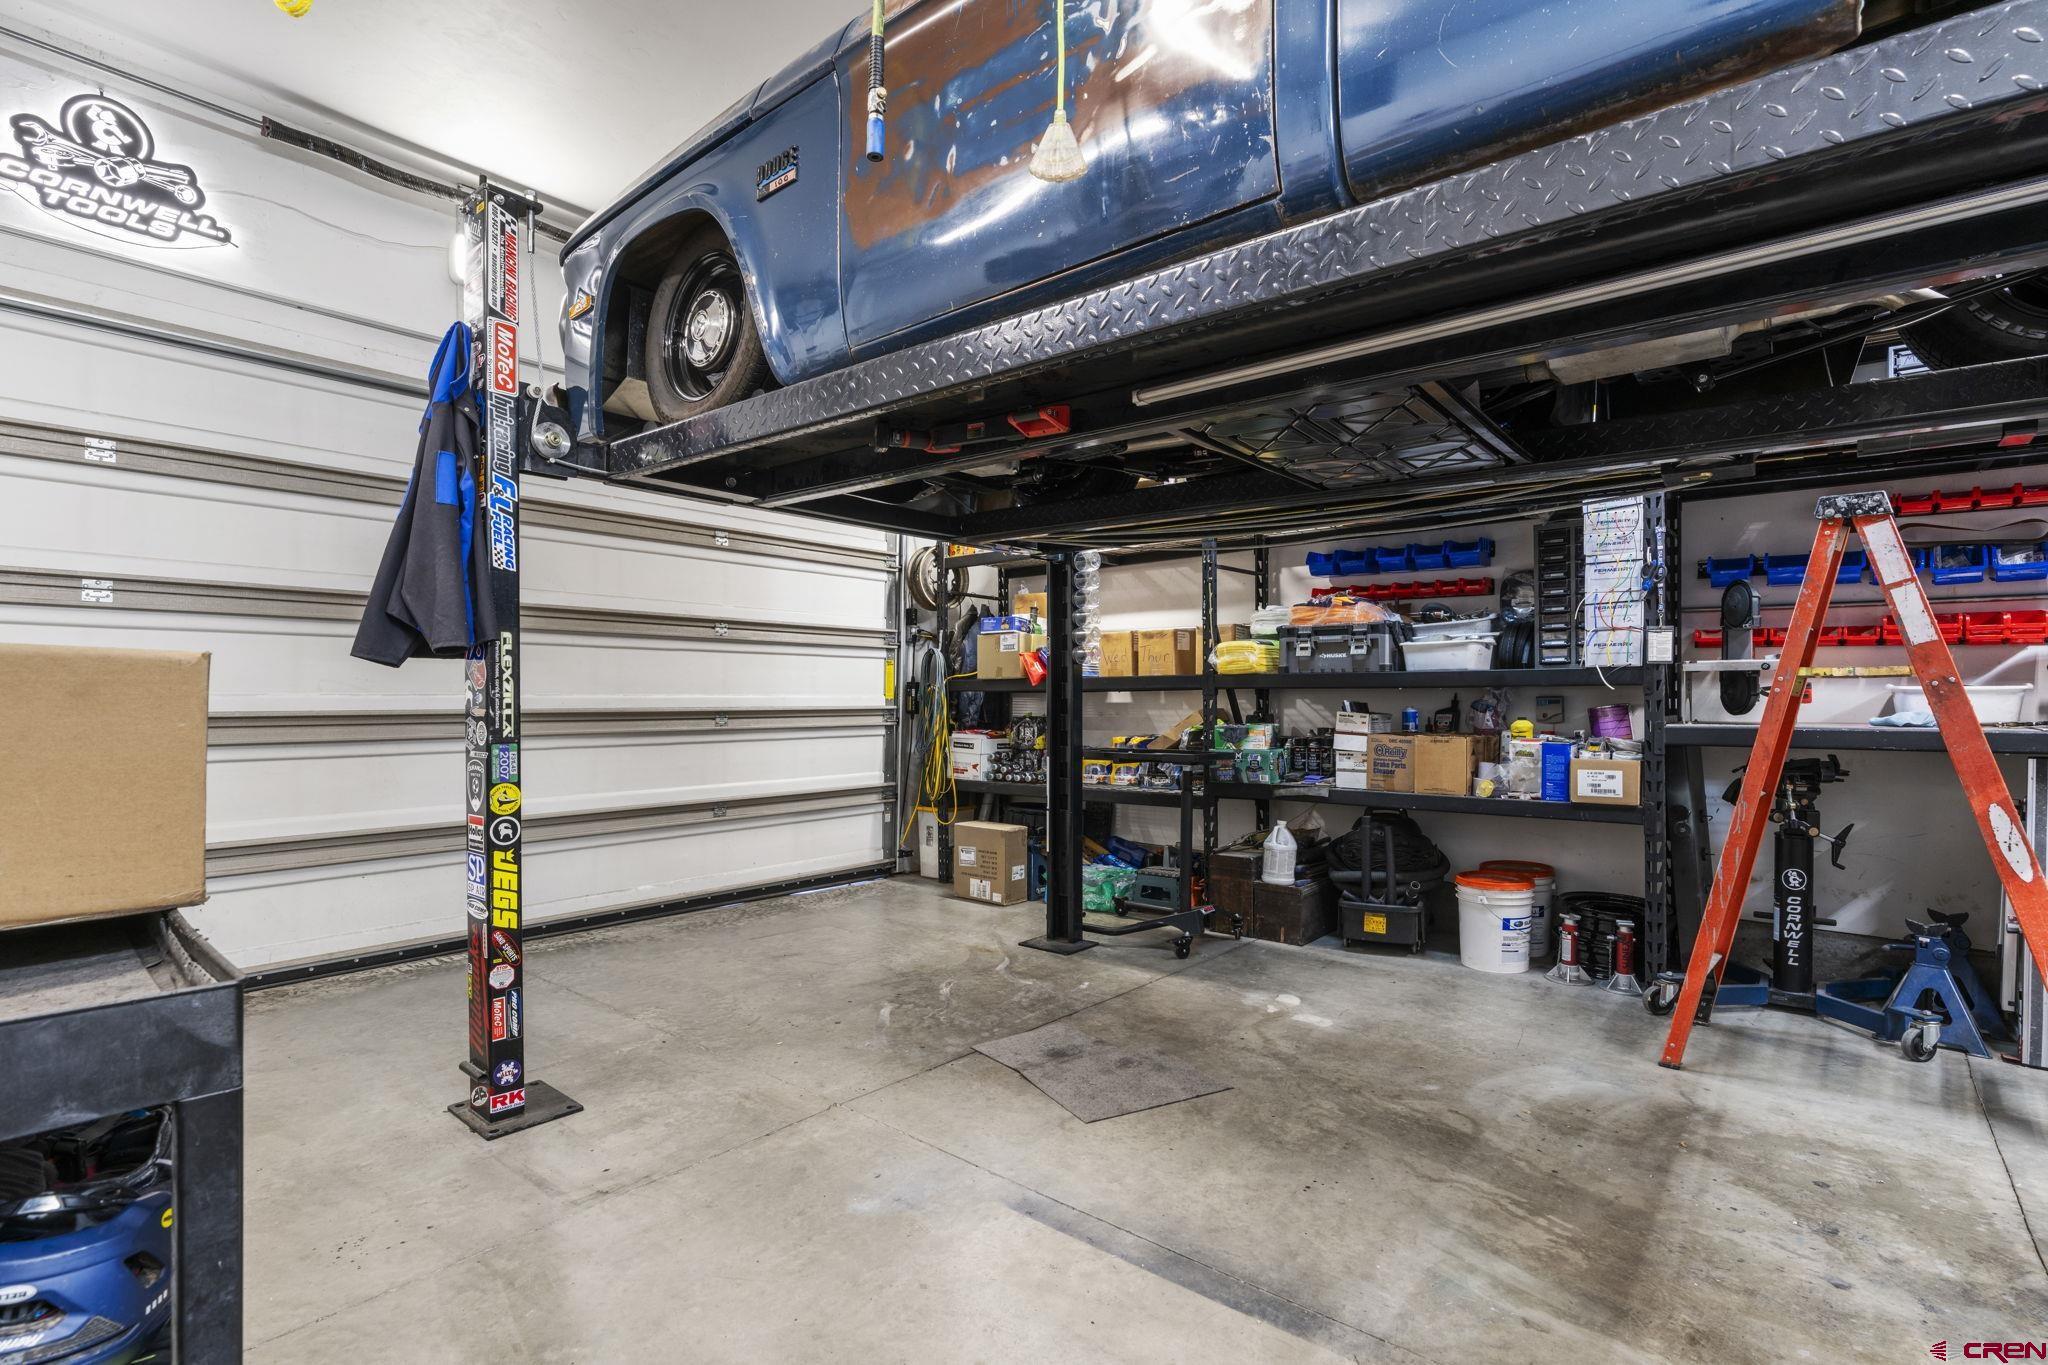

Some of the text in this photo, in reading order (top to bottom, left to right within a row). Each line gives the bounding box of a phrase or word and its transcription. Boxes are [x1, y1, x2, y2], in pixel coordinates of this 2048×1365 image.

[43, 187, 177, 238] TOOLS
[505, 231, 517, 321] MANCINI RACING
[497, 325, 514, 390] MoTeC
[491, 510, 503, 549] FUEL
[502, 515, 517, 572] RACING
[1101, 646, 1127, 665] Wed
[501, 632, 514, 738] FLEXZILLA
[500, 751, 509, 780] 2007
[468, 824, 484, 842] Holley
[468, 854, 485, 883] SP
[493, 850, 518, 930] JEGS
[1783, 896, 1803, 966] CORNWELL
[493, 1001, 502, 1026] MoTeC
[511, 1010, 519, 1037] COMP
[491, 1089, 524, 1109] RK
